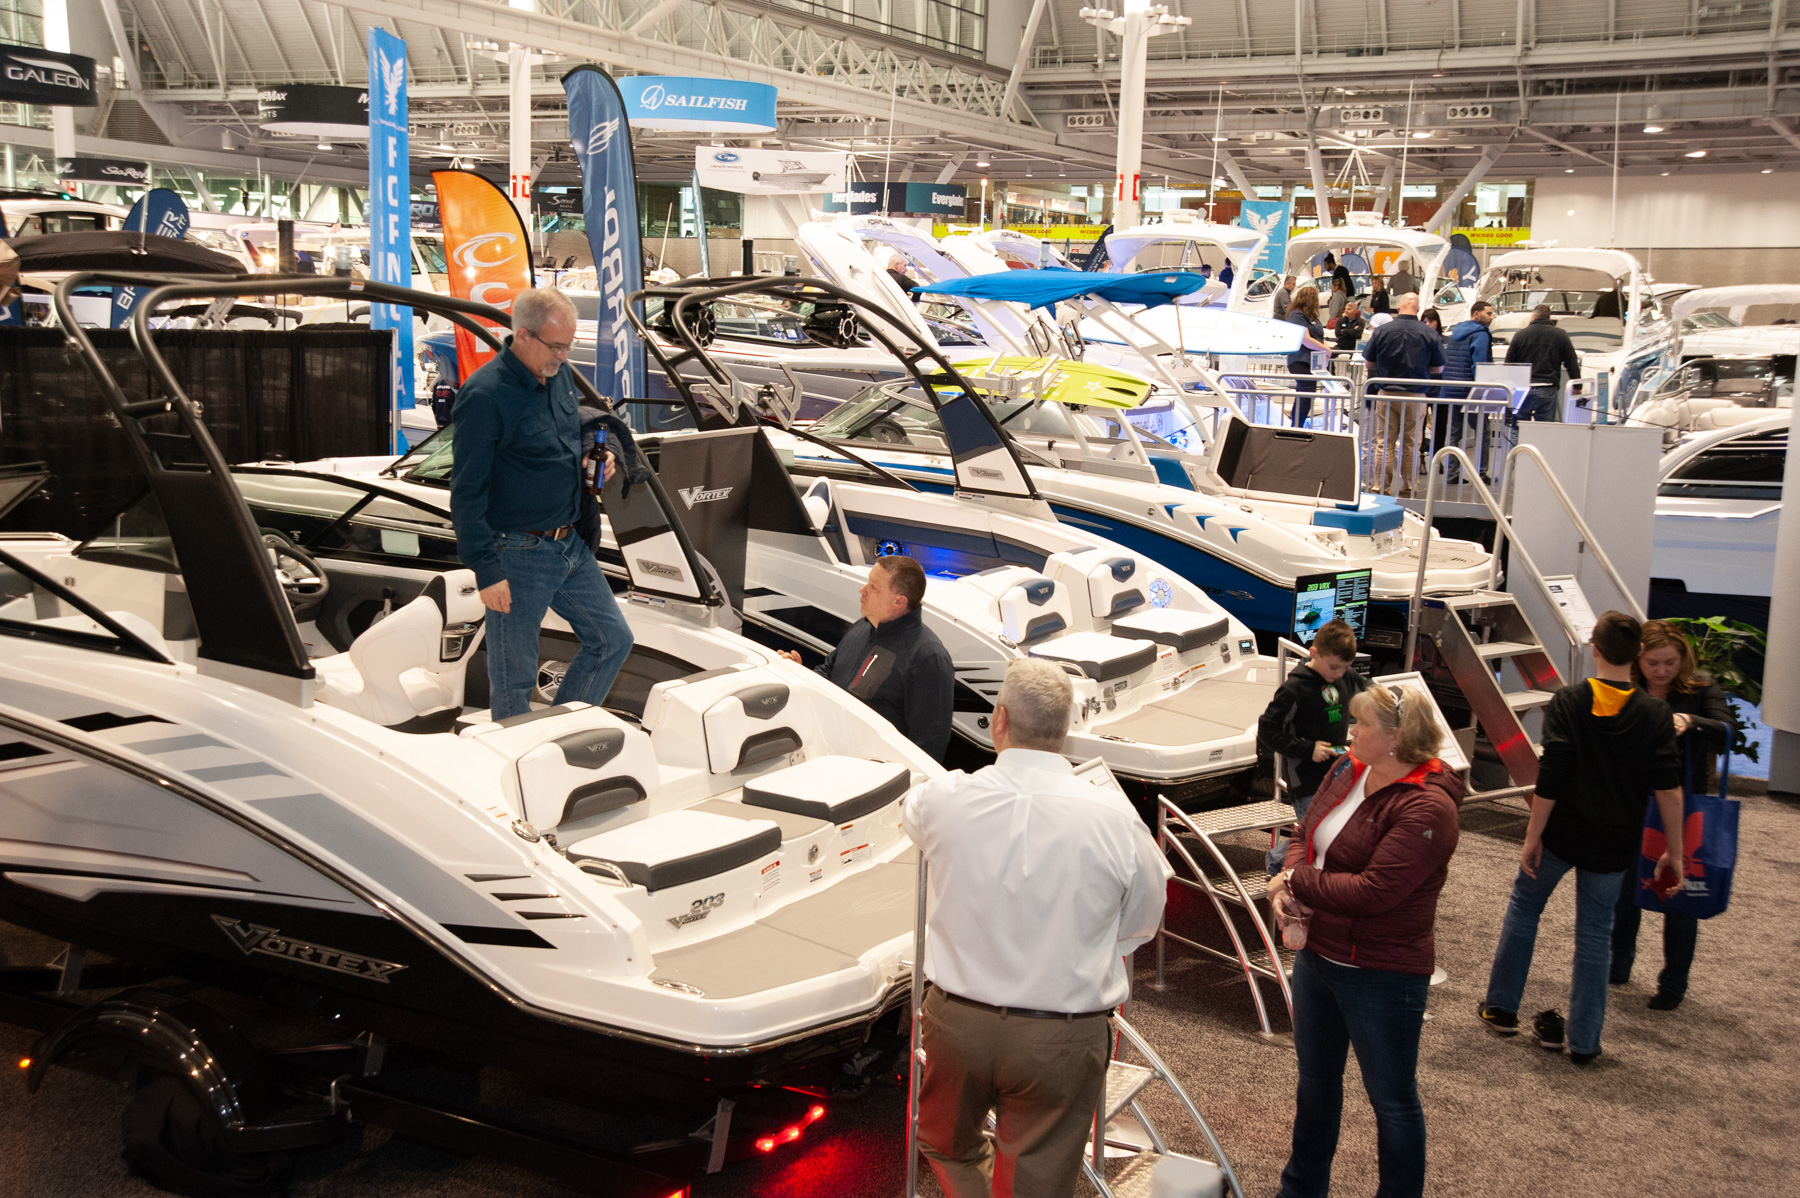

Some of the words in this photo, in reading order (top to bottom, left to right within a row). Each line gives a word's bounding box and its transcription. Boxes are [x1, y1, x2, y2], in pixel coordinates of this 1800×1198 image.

[7, 66, 90, 91] GALEON
[665, 94, 749, 111] SAILFISH
[690, 892, 726, 915] 203
[210, 913, 410, 985] VORTEX
